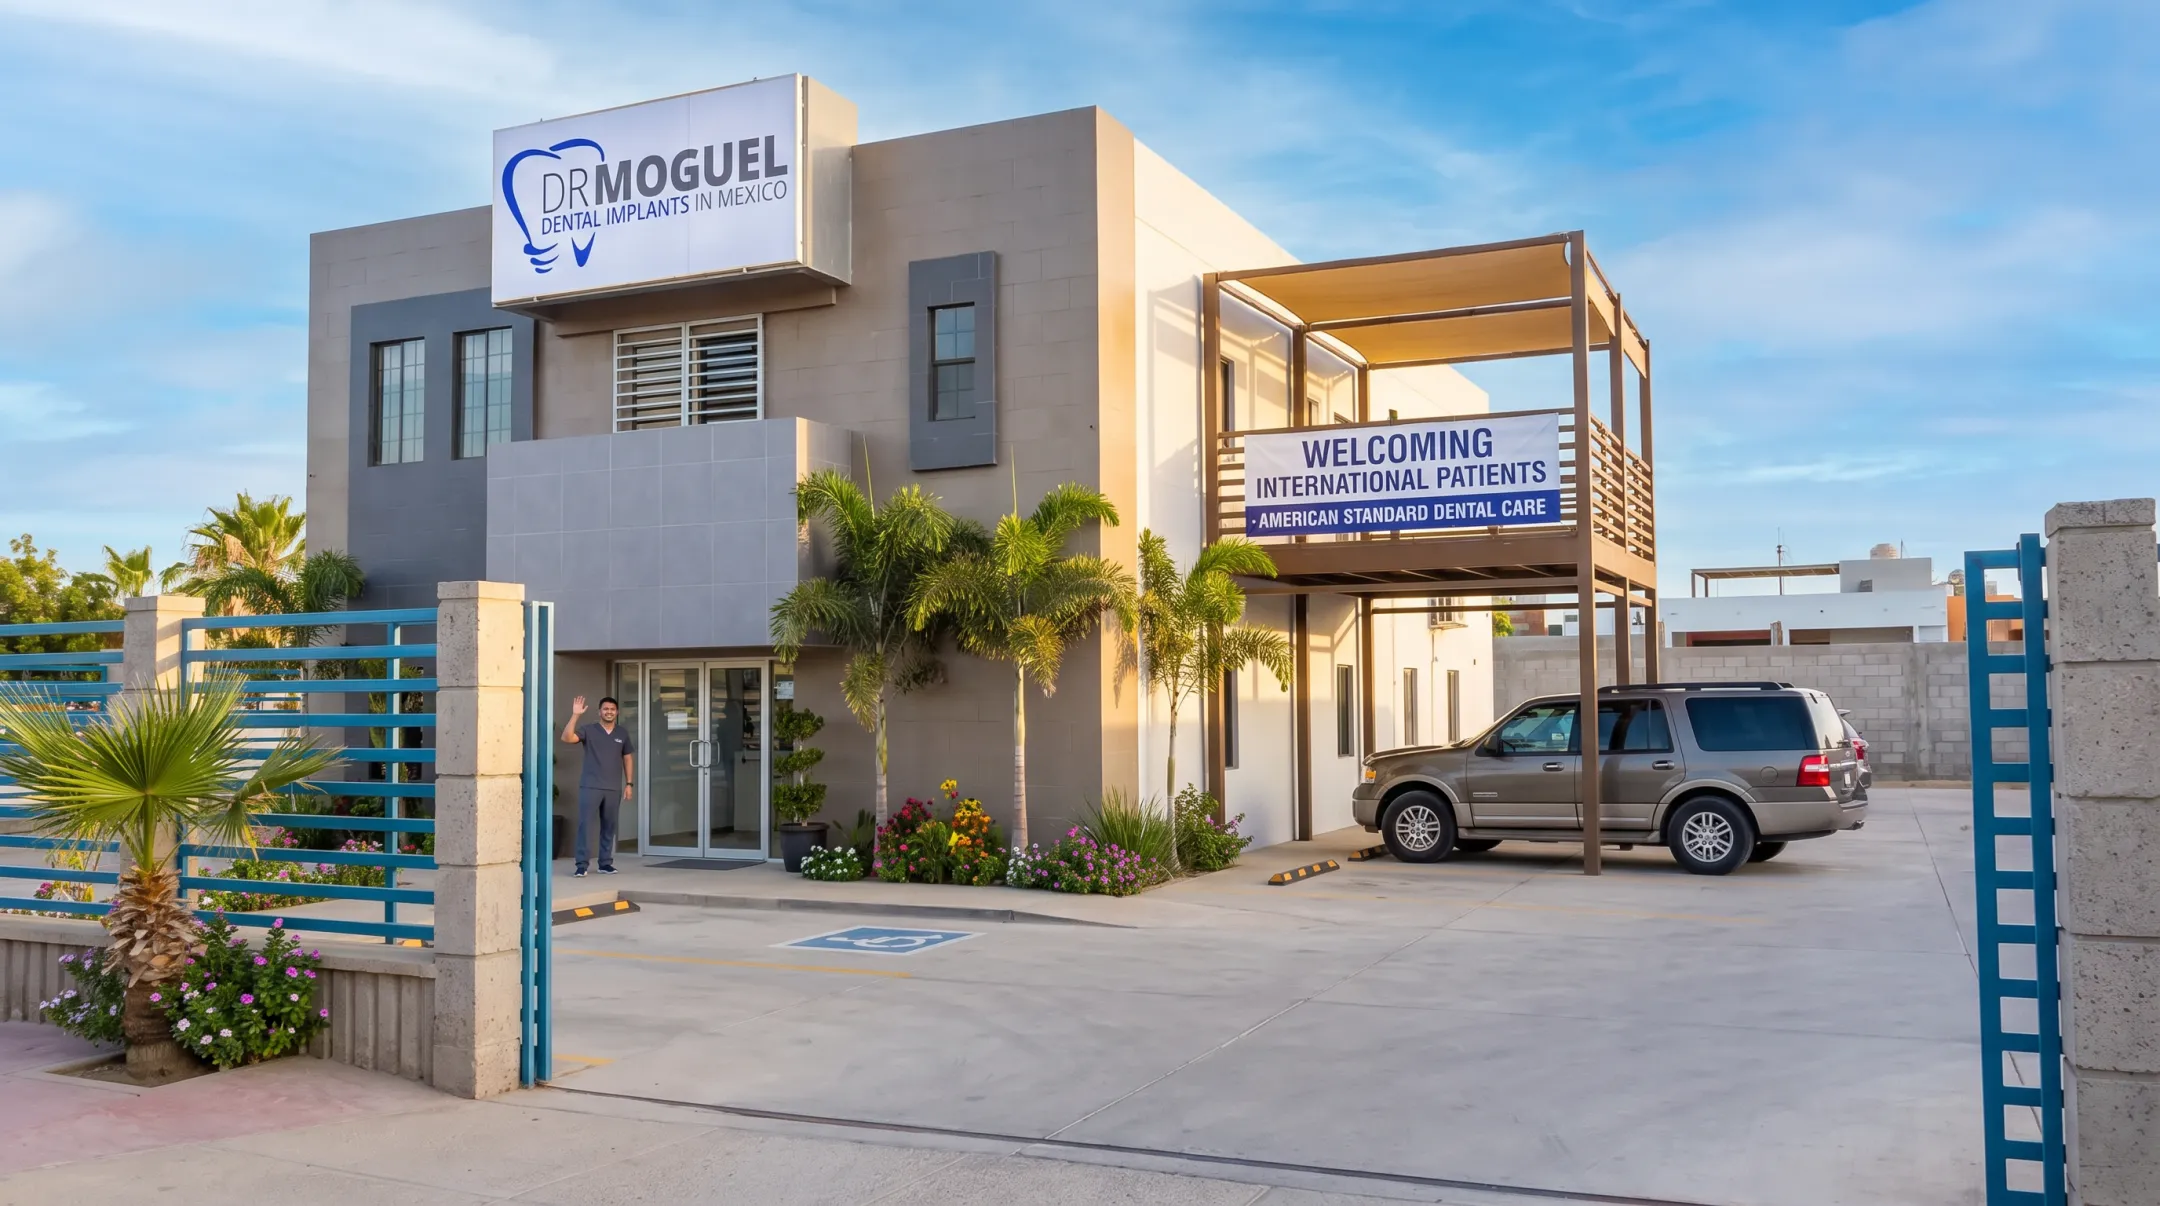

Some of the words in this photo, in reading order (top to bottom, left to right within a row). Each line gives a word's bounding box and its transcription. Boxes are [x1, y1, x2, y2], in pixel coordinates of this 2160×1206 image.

[541, 209, 602, 236] DENTAL
[606, 194, 690, 226] IMPLANTS
[695, 191, 712, 212] IN
[718, 180, 787, 209] MEXICO
[1302, 427, 1493, 469] WELCOMING
[1256, 468, 1430, 499] INTERNATIONAL
[1437, 460, 1547, 489] PATIENTS
[1258, 509, 1339, 529] AMERICAN
[1343, 504, 1428, 525] STANDARD
[1433, 501, 1497, 521] DENTAL
[1501, 498, 1546, 517] CARE
